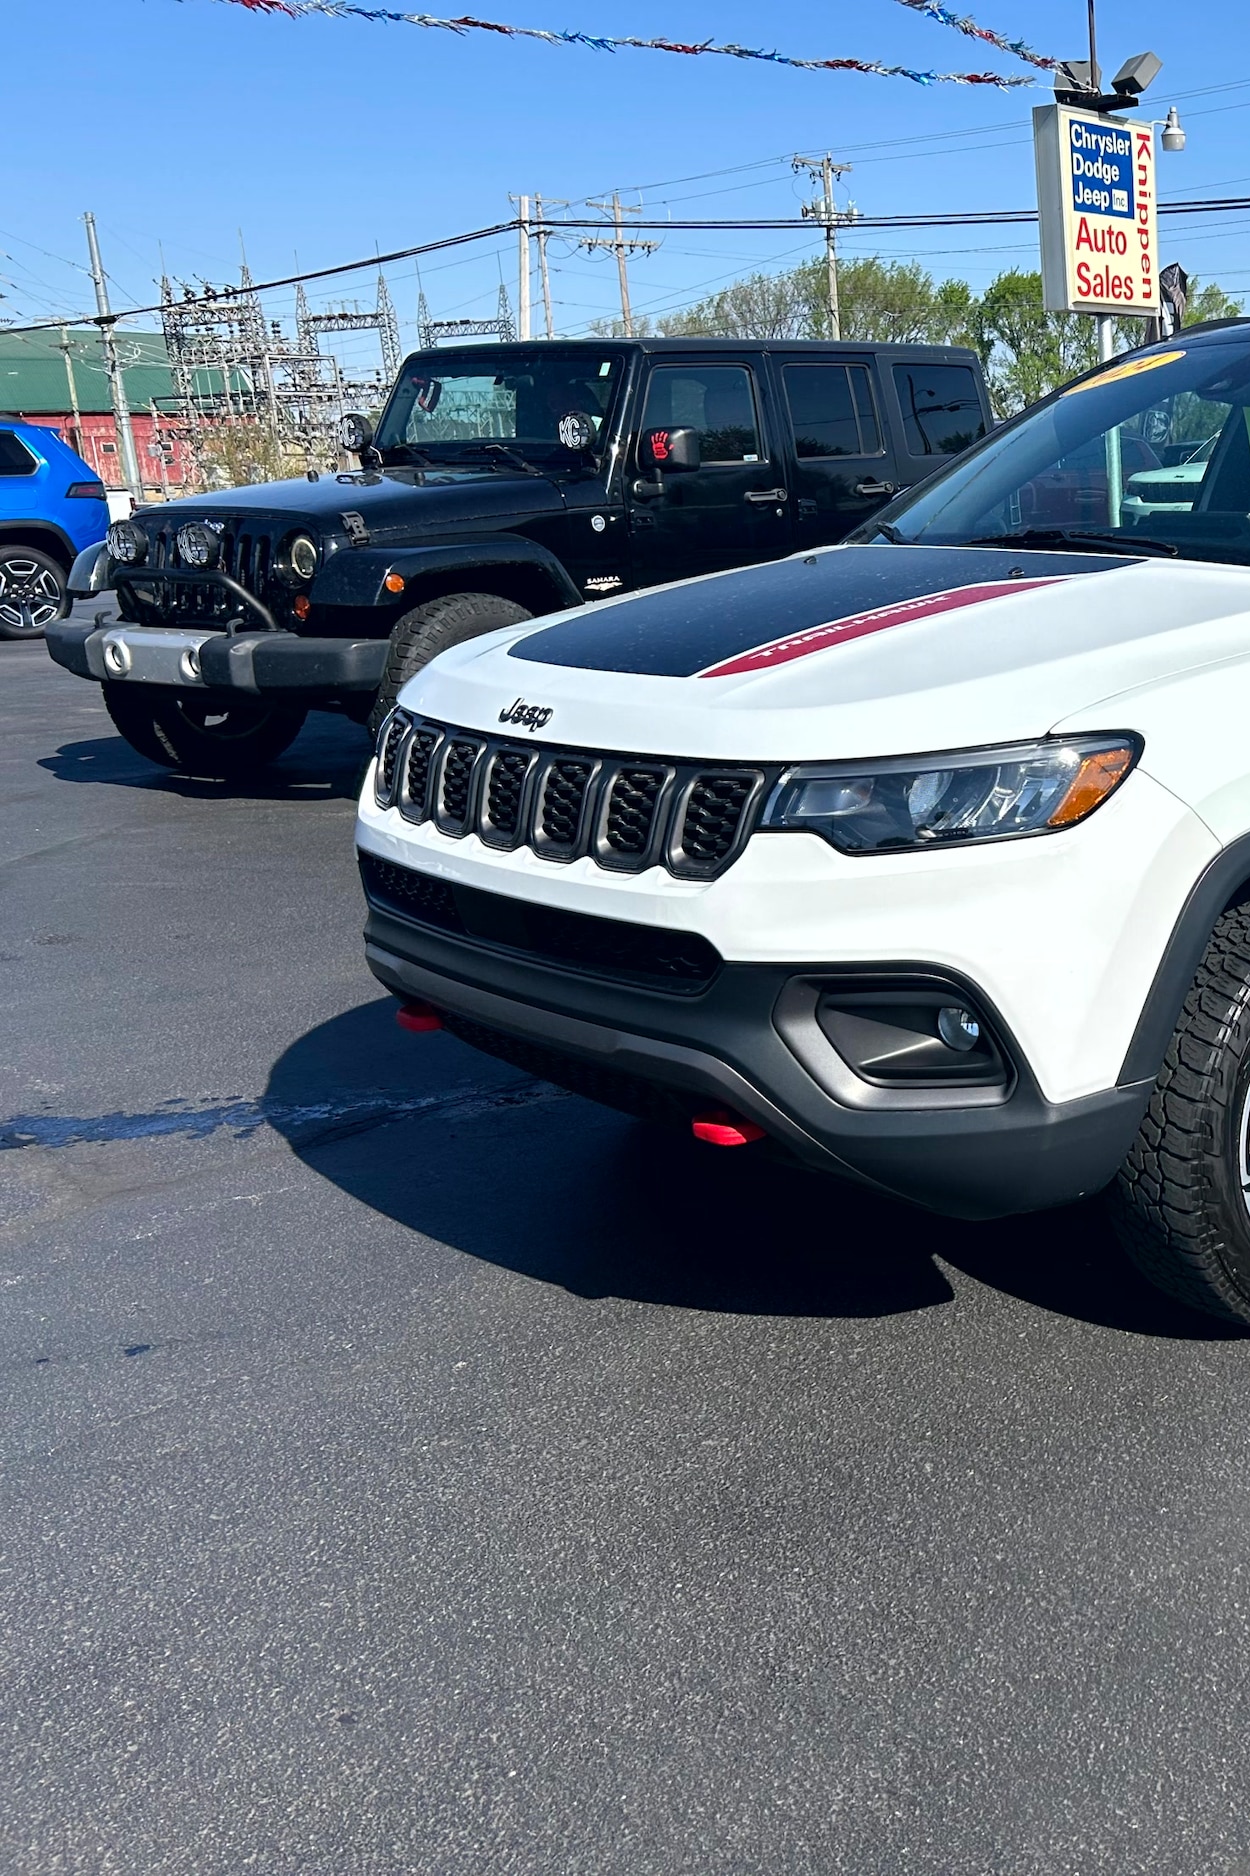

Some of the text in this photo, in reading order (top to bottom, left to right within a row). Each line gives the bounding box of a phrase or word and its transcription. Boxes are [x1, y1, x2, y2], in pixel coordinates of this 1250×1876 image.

[1070, 123, 1131, 156] Chrysler
[1073, 153, 1120, 185] Dodge
[1074, 181, 1110, 210] Jeep
[1136, 133, 1152, 299] Knippen
[1075, 216, 1127, 255] Auto
[1076, 261, 1134, 300] Sales
[337, 417, 355, 447] KC
[559, 416, 580, 447] KC
[586, 575, 620, 584] SAMARA
[748, 596, 951, 659] TRAILHAWK
[498, 697, 554, 732] Jeep
